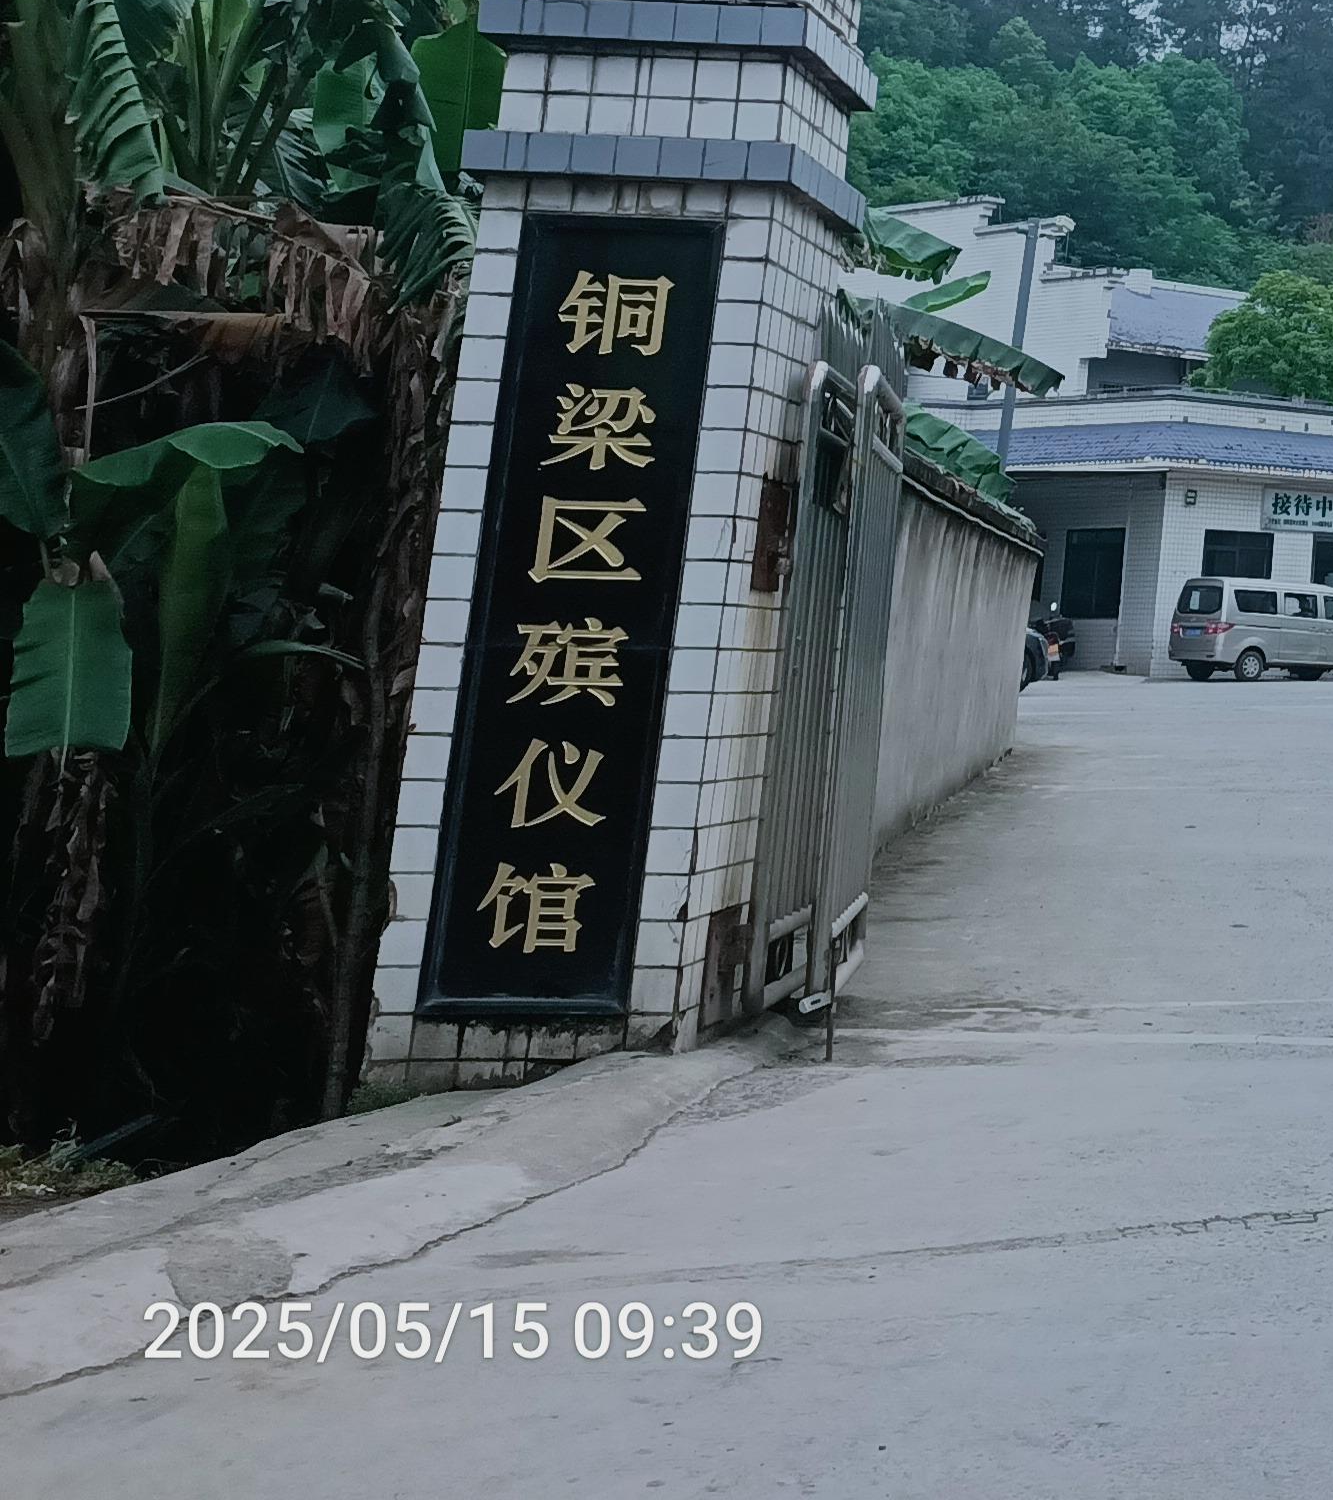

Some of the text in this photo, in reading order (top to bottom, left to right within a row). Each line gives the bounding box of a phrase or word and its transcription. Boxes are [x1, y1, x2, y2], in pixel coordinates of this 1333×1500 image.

[477, 269, 675, 956] 铜梁区殡仪馆
